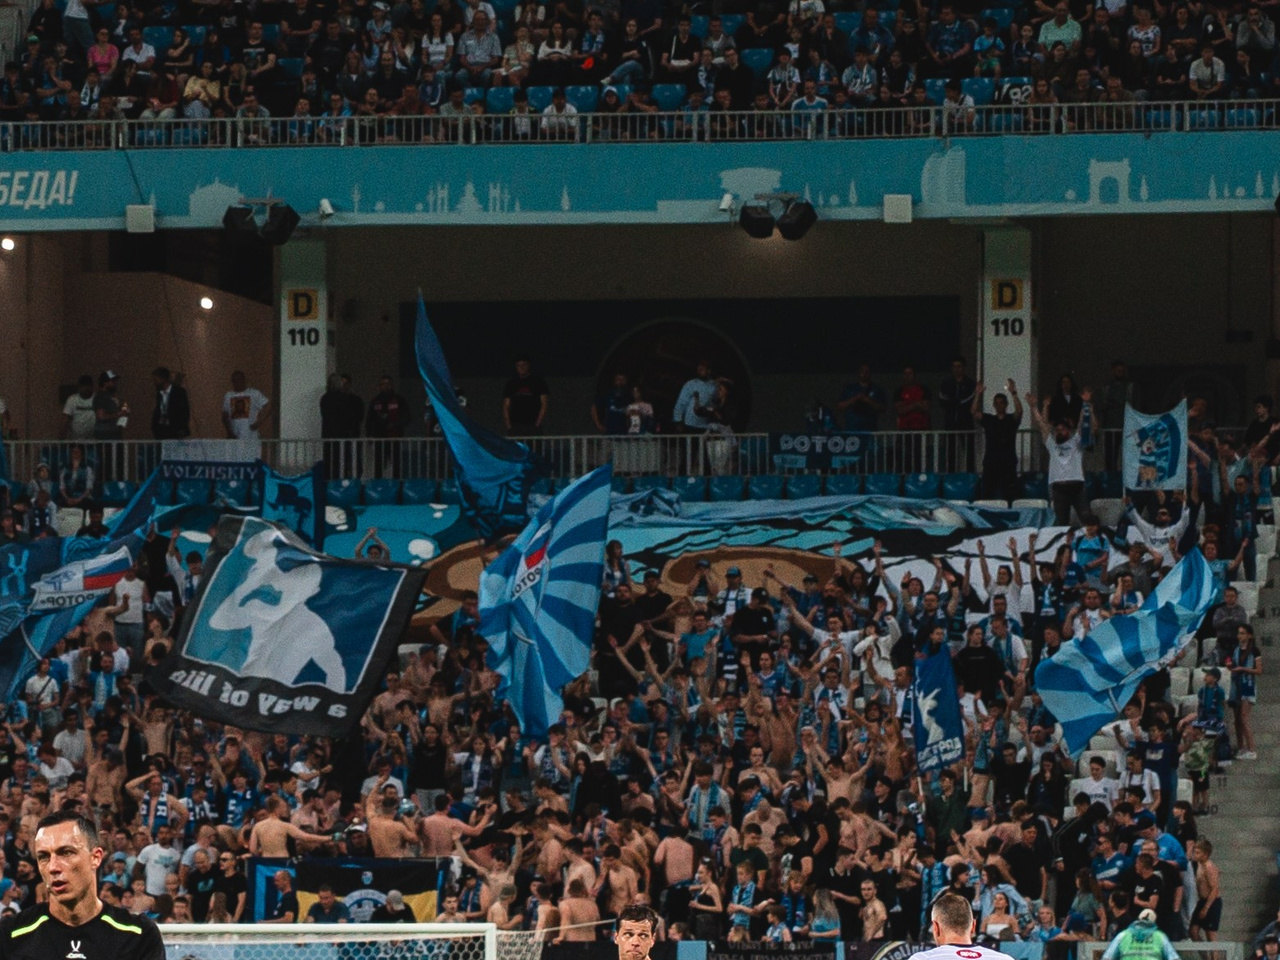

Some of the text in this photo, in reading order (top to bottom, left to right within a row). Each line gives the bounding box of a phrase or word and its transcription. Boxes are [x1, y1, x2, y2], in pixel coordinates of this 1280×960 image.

[294, 293, 312, 316] D
[998, 282, 1017, 308] D
[288, 328, 319, 346] 110
[991, 318, 1024, 336] 110
